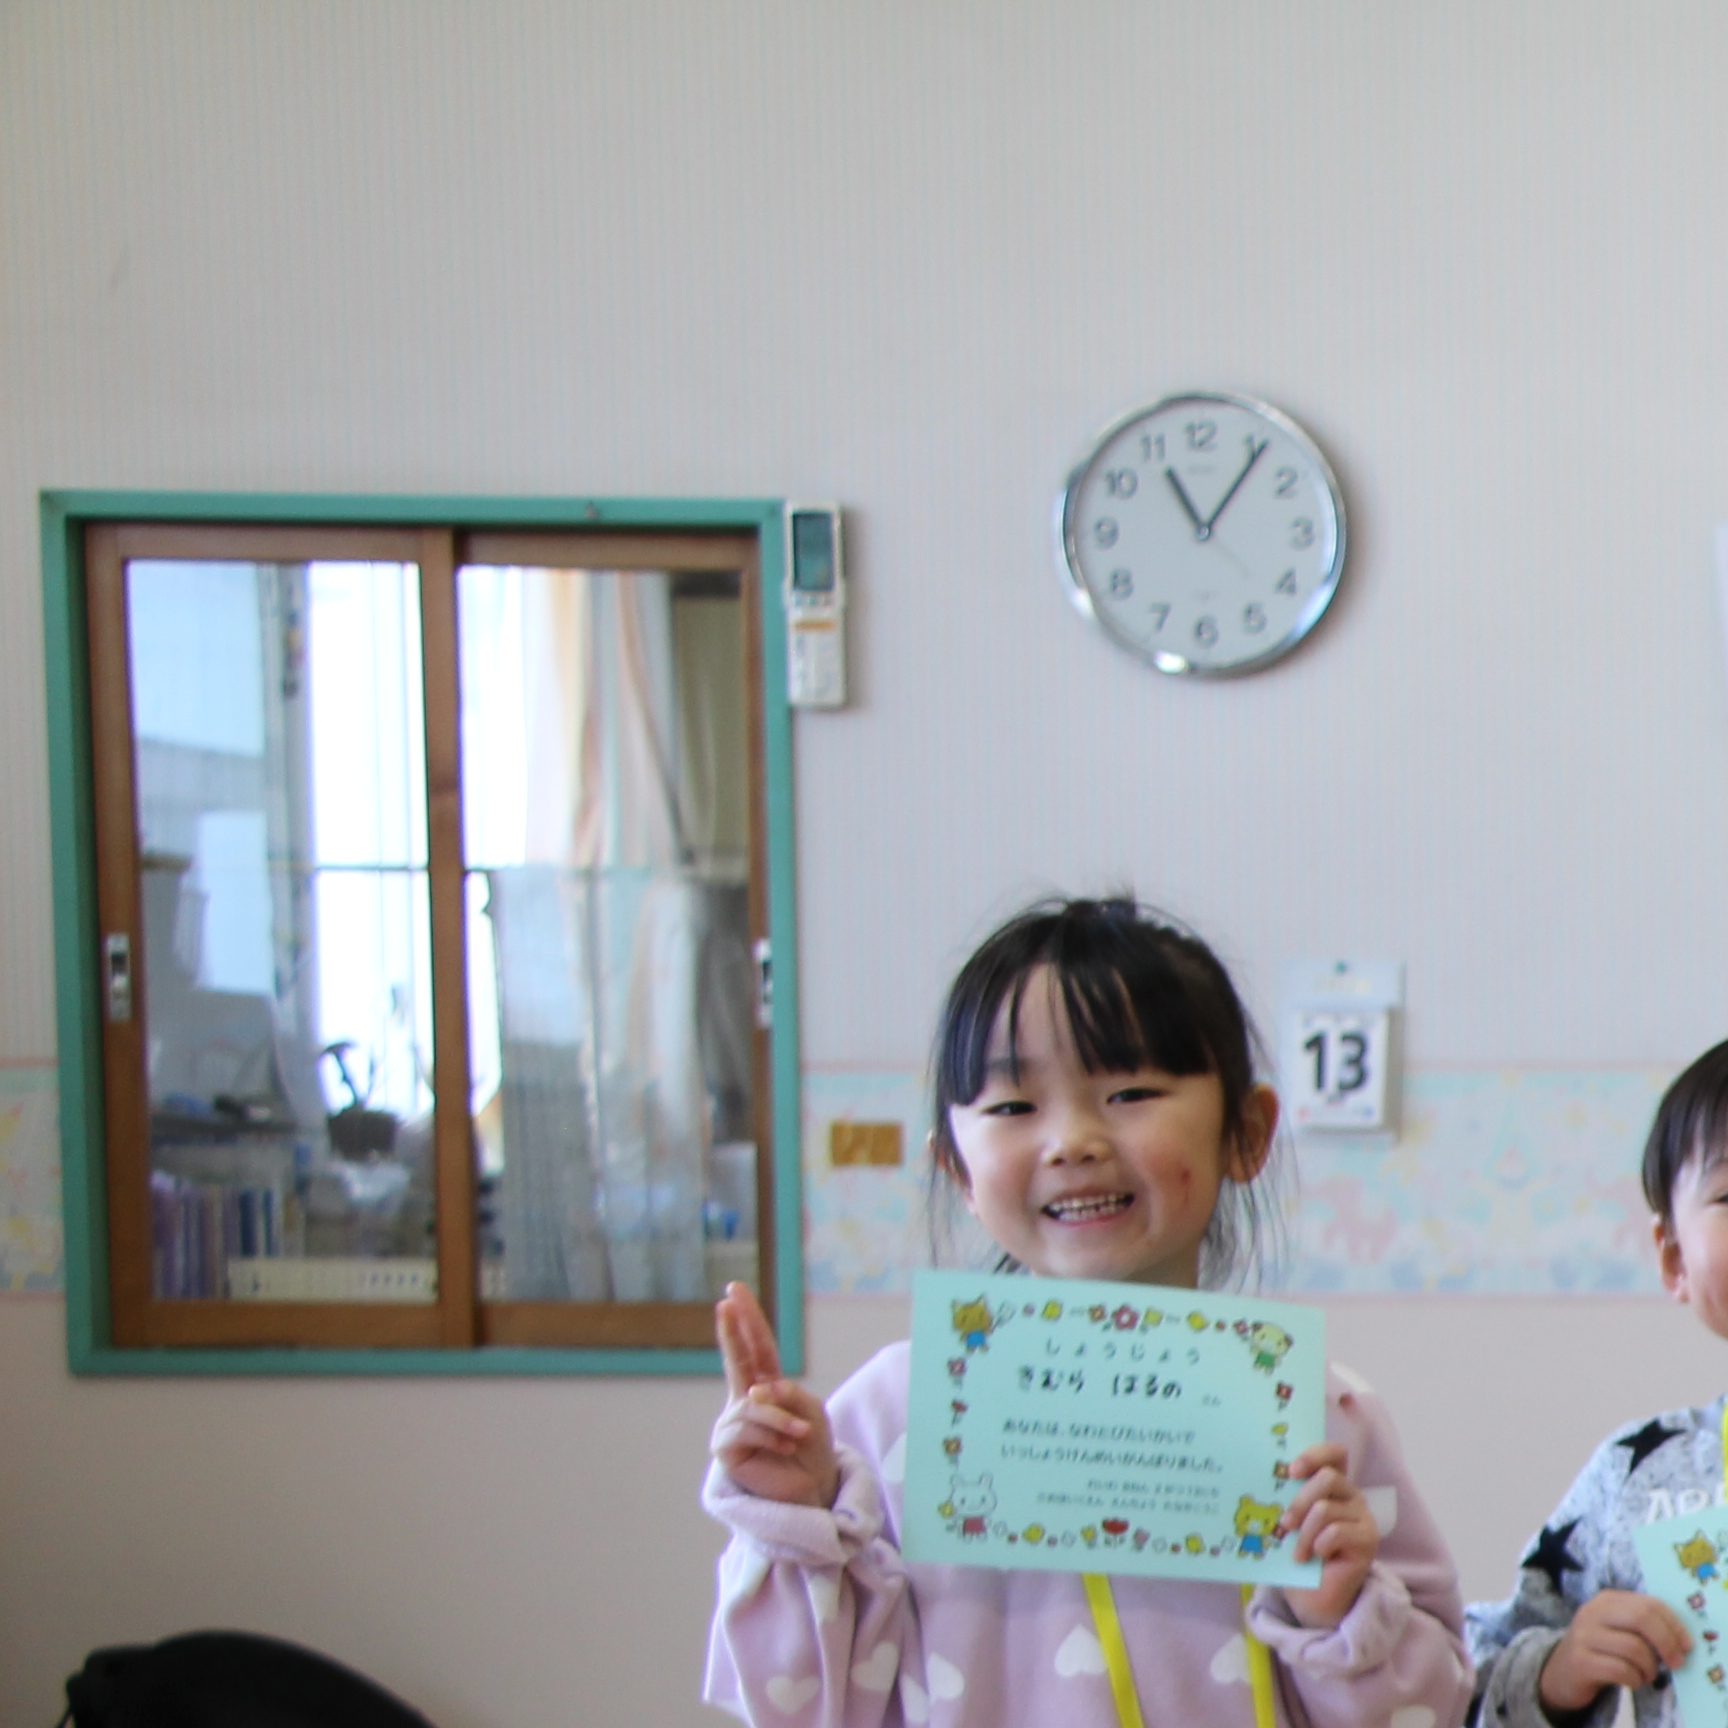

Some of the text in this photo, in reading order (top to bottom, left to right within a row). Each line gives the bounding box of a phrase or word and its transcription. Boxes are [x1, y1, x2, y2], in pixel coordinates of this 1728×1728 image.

[1140, 434, 1166, 462] 11
[1185, 419, 1217, 452] 12
[1104, 467, 1139, 500] 10
[1275, 465, 1299, 497] 2
[1094, 516, 1120, 549] 9
[1290, 516, 1314, 550] 3
[1109, 567, 1134, 600] 8
[1274, 566, 1297, 597] 4
[1150, 602, 1171, 633] 7
[1195, 614, 1219, 648] 6
[1244, 602, 1267, 635] 5
[1304, 1030, 1369, 1093] 13
[1046, 1337, 1200, 1365] しょうじょう
